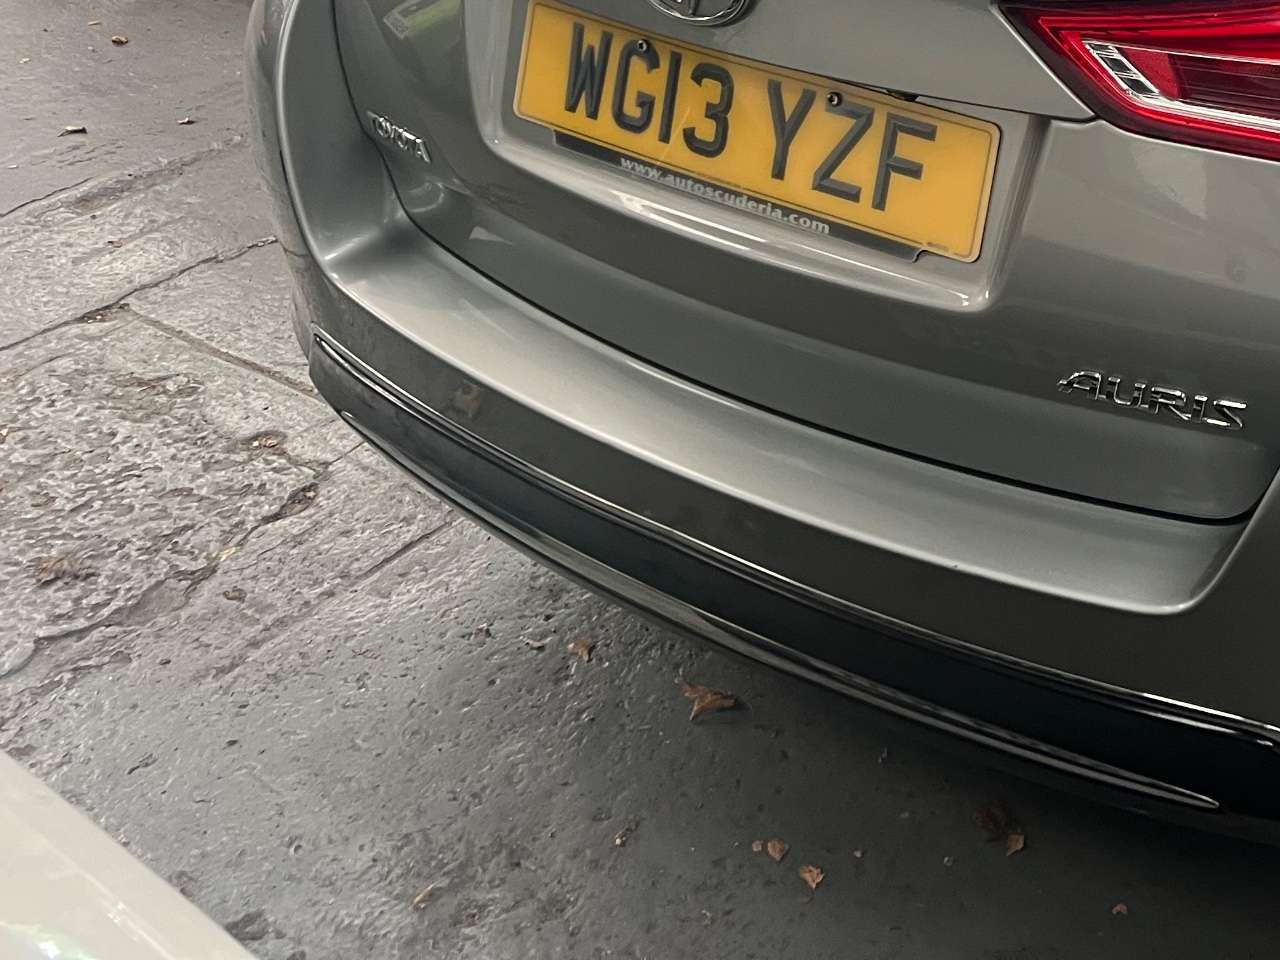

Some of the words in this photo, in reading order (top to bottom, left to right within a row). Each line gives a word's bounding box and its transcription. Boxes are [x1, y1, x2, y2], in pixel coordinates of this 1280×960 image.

[564, 22, 735, 159] WG13
[767, 79, 938, 212] YZF
[619, 156, 831, 235] www.autoscuderia.com
[1056, 371, 1248, 430] AURIS
